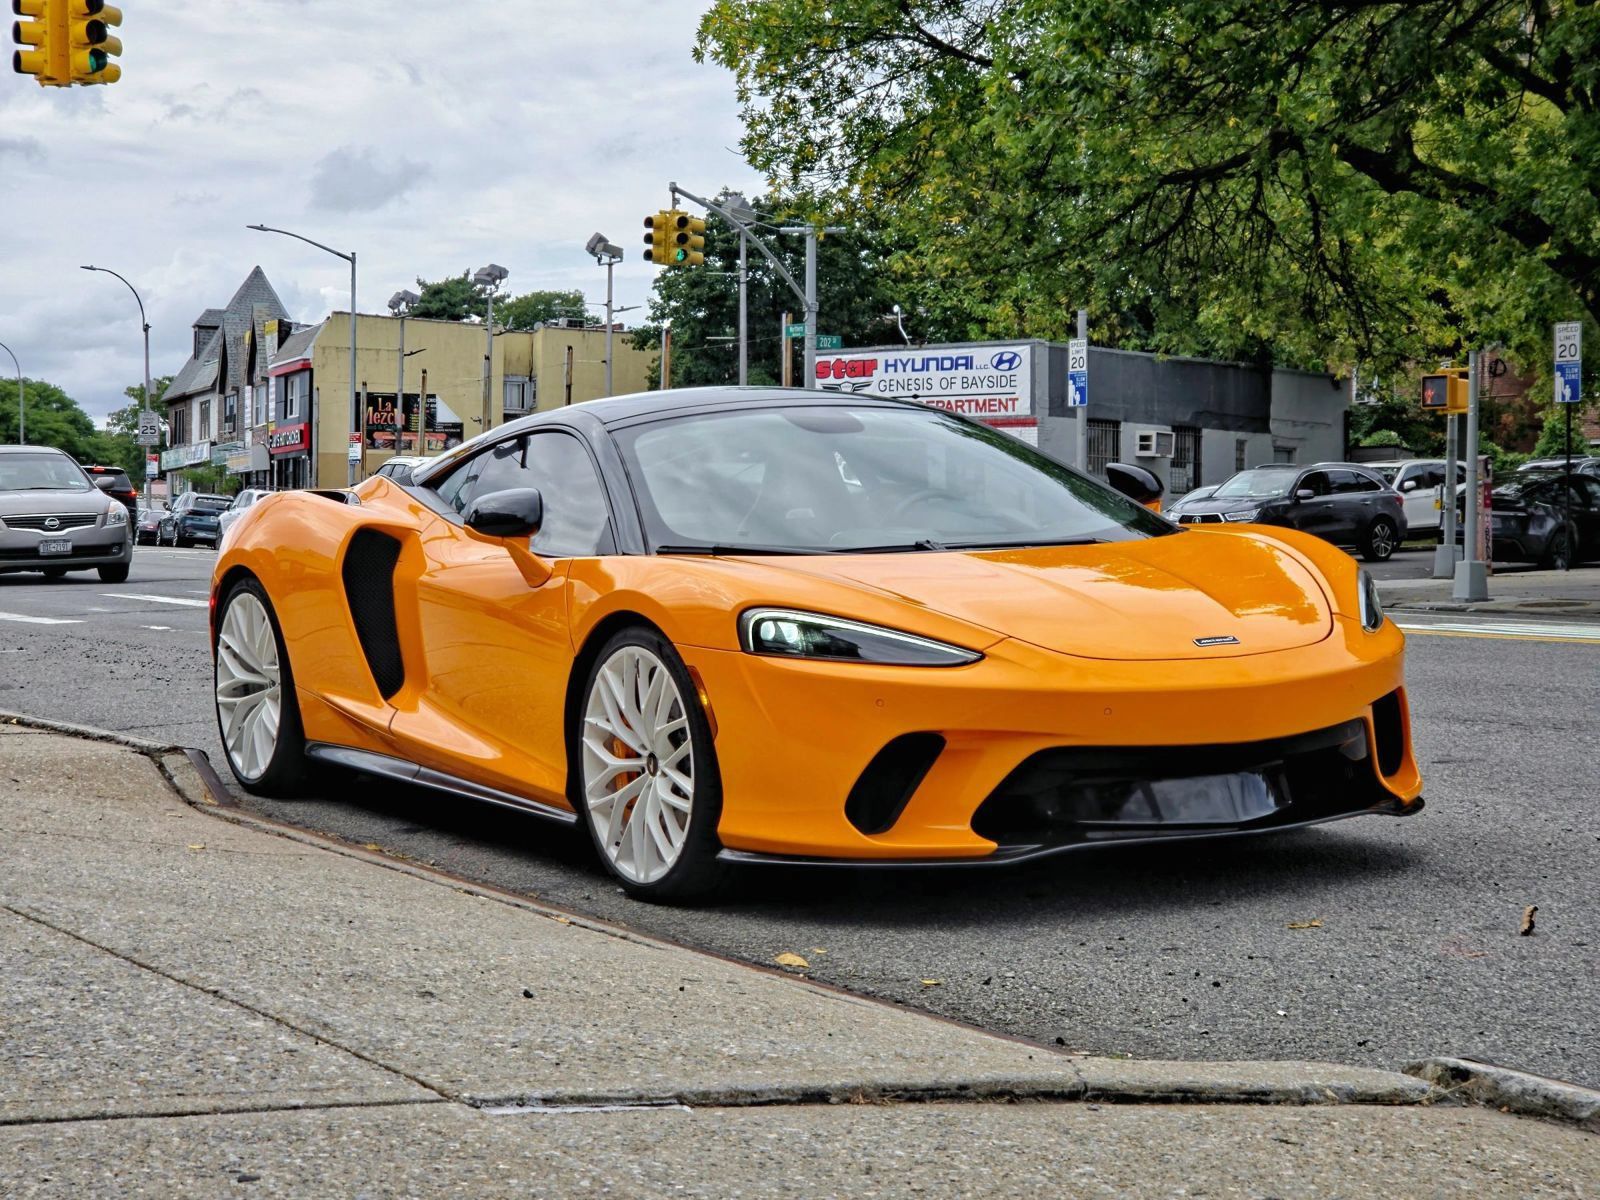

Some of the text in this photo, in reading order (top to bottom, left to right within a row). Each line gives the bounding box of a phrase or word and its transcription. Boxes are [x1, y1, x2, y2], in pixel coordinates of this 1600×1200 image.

[820, 337, 831, 347] 202
[1558, 343, 1577, 358] 20
[816, 358, 878, 379] star
[884, 355, 974, 374] HYUNDAI
[1071, 356, 1085, 369] 20
[878, 374, 1017, 392] GENESIS OF BAYSIDE
[378, 397, 392, 411] La
[917, 397, 1019, 413] PARTMENT
[141, 425, 157, 434] 25
